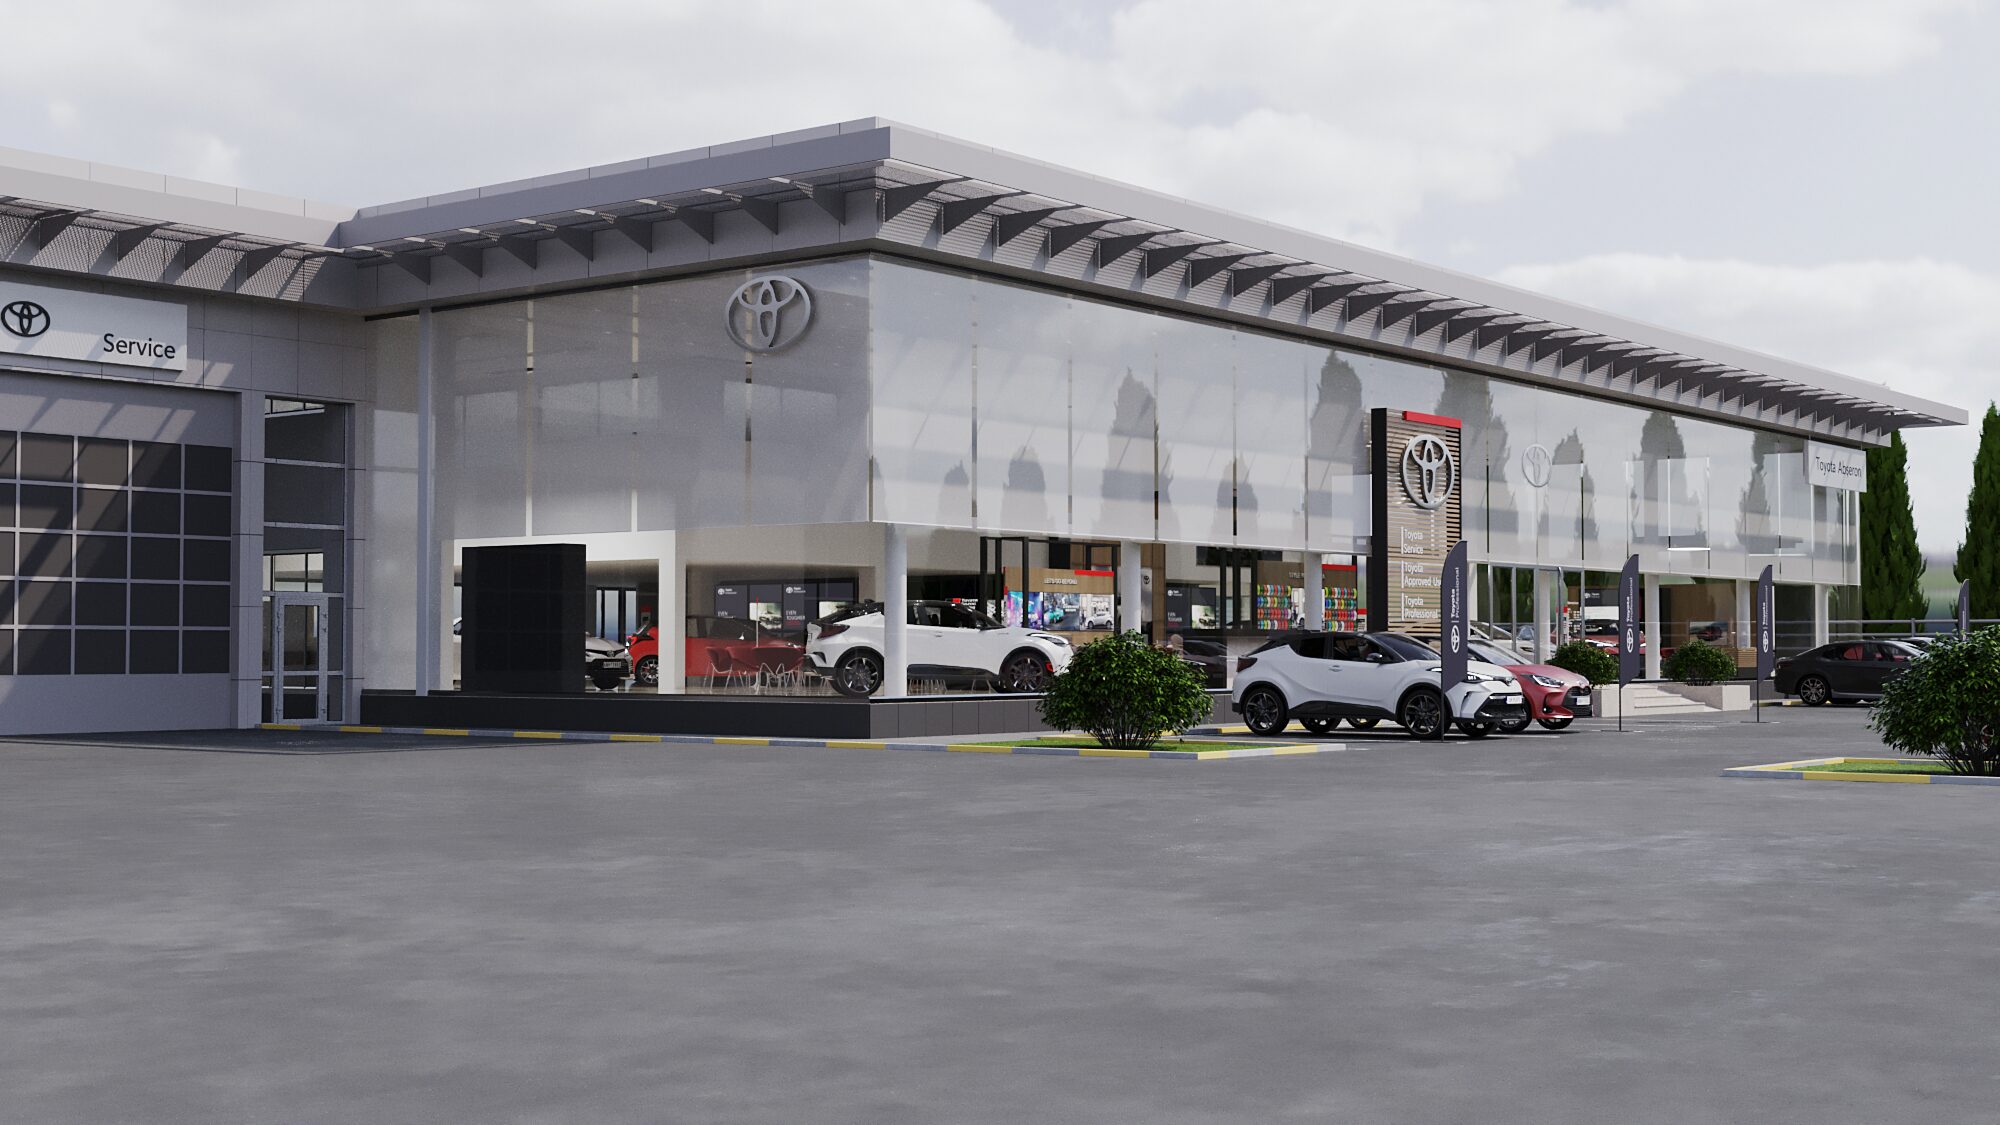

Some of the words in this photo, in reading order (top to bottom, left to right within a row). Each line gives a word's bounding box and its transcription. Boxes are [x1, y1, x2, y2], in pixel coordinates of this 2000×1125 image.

[103, 333, 176, 359] Service
[1816, 456, 1836, 476] Toyota
[1404, 529, 1424, 540] Toyota
[1403, 544, 1424, 554] Service
[1404, 563, 1424, 573] Toyota
[1405, 576, 1431, 587] Approved
[1404, 596, 1424, 607] Toyota
[1405, 608, 1438, 619] Professional
